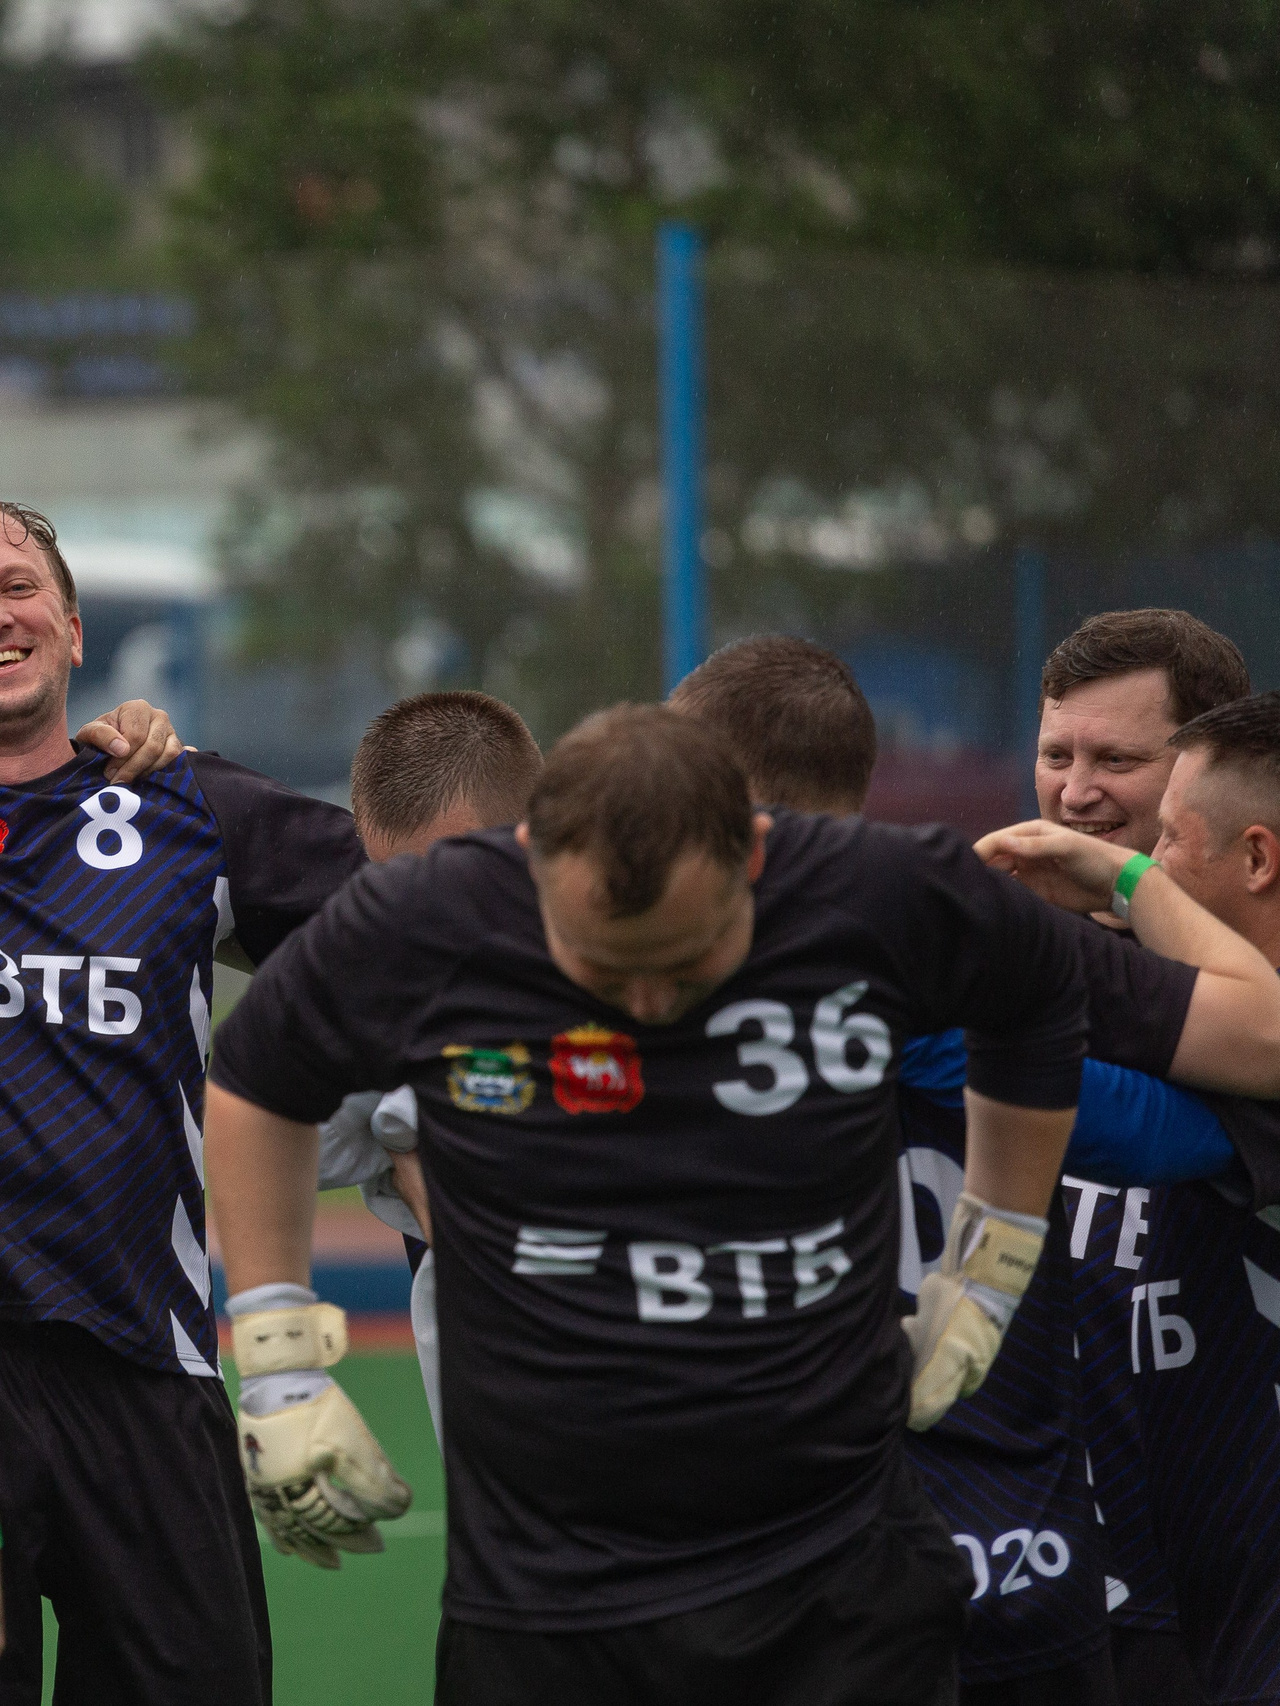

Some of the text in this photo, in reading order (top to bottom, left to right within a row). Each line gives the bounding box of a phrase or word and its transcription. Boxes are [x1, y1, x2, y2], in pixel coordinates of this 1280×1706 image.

[76, 784, 144, 871] 8
[705, 980, 893, 1116] 36
[626, 1218, 853, 1323] ВТБ
